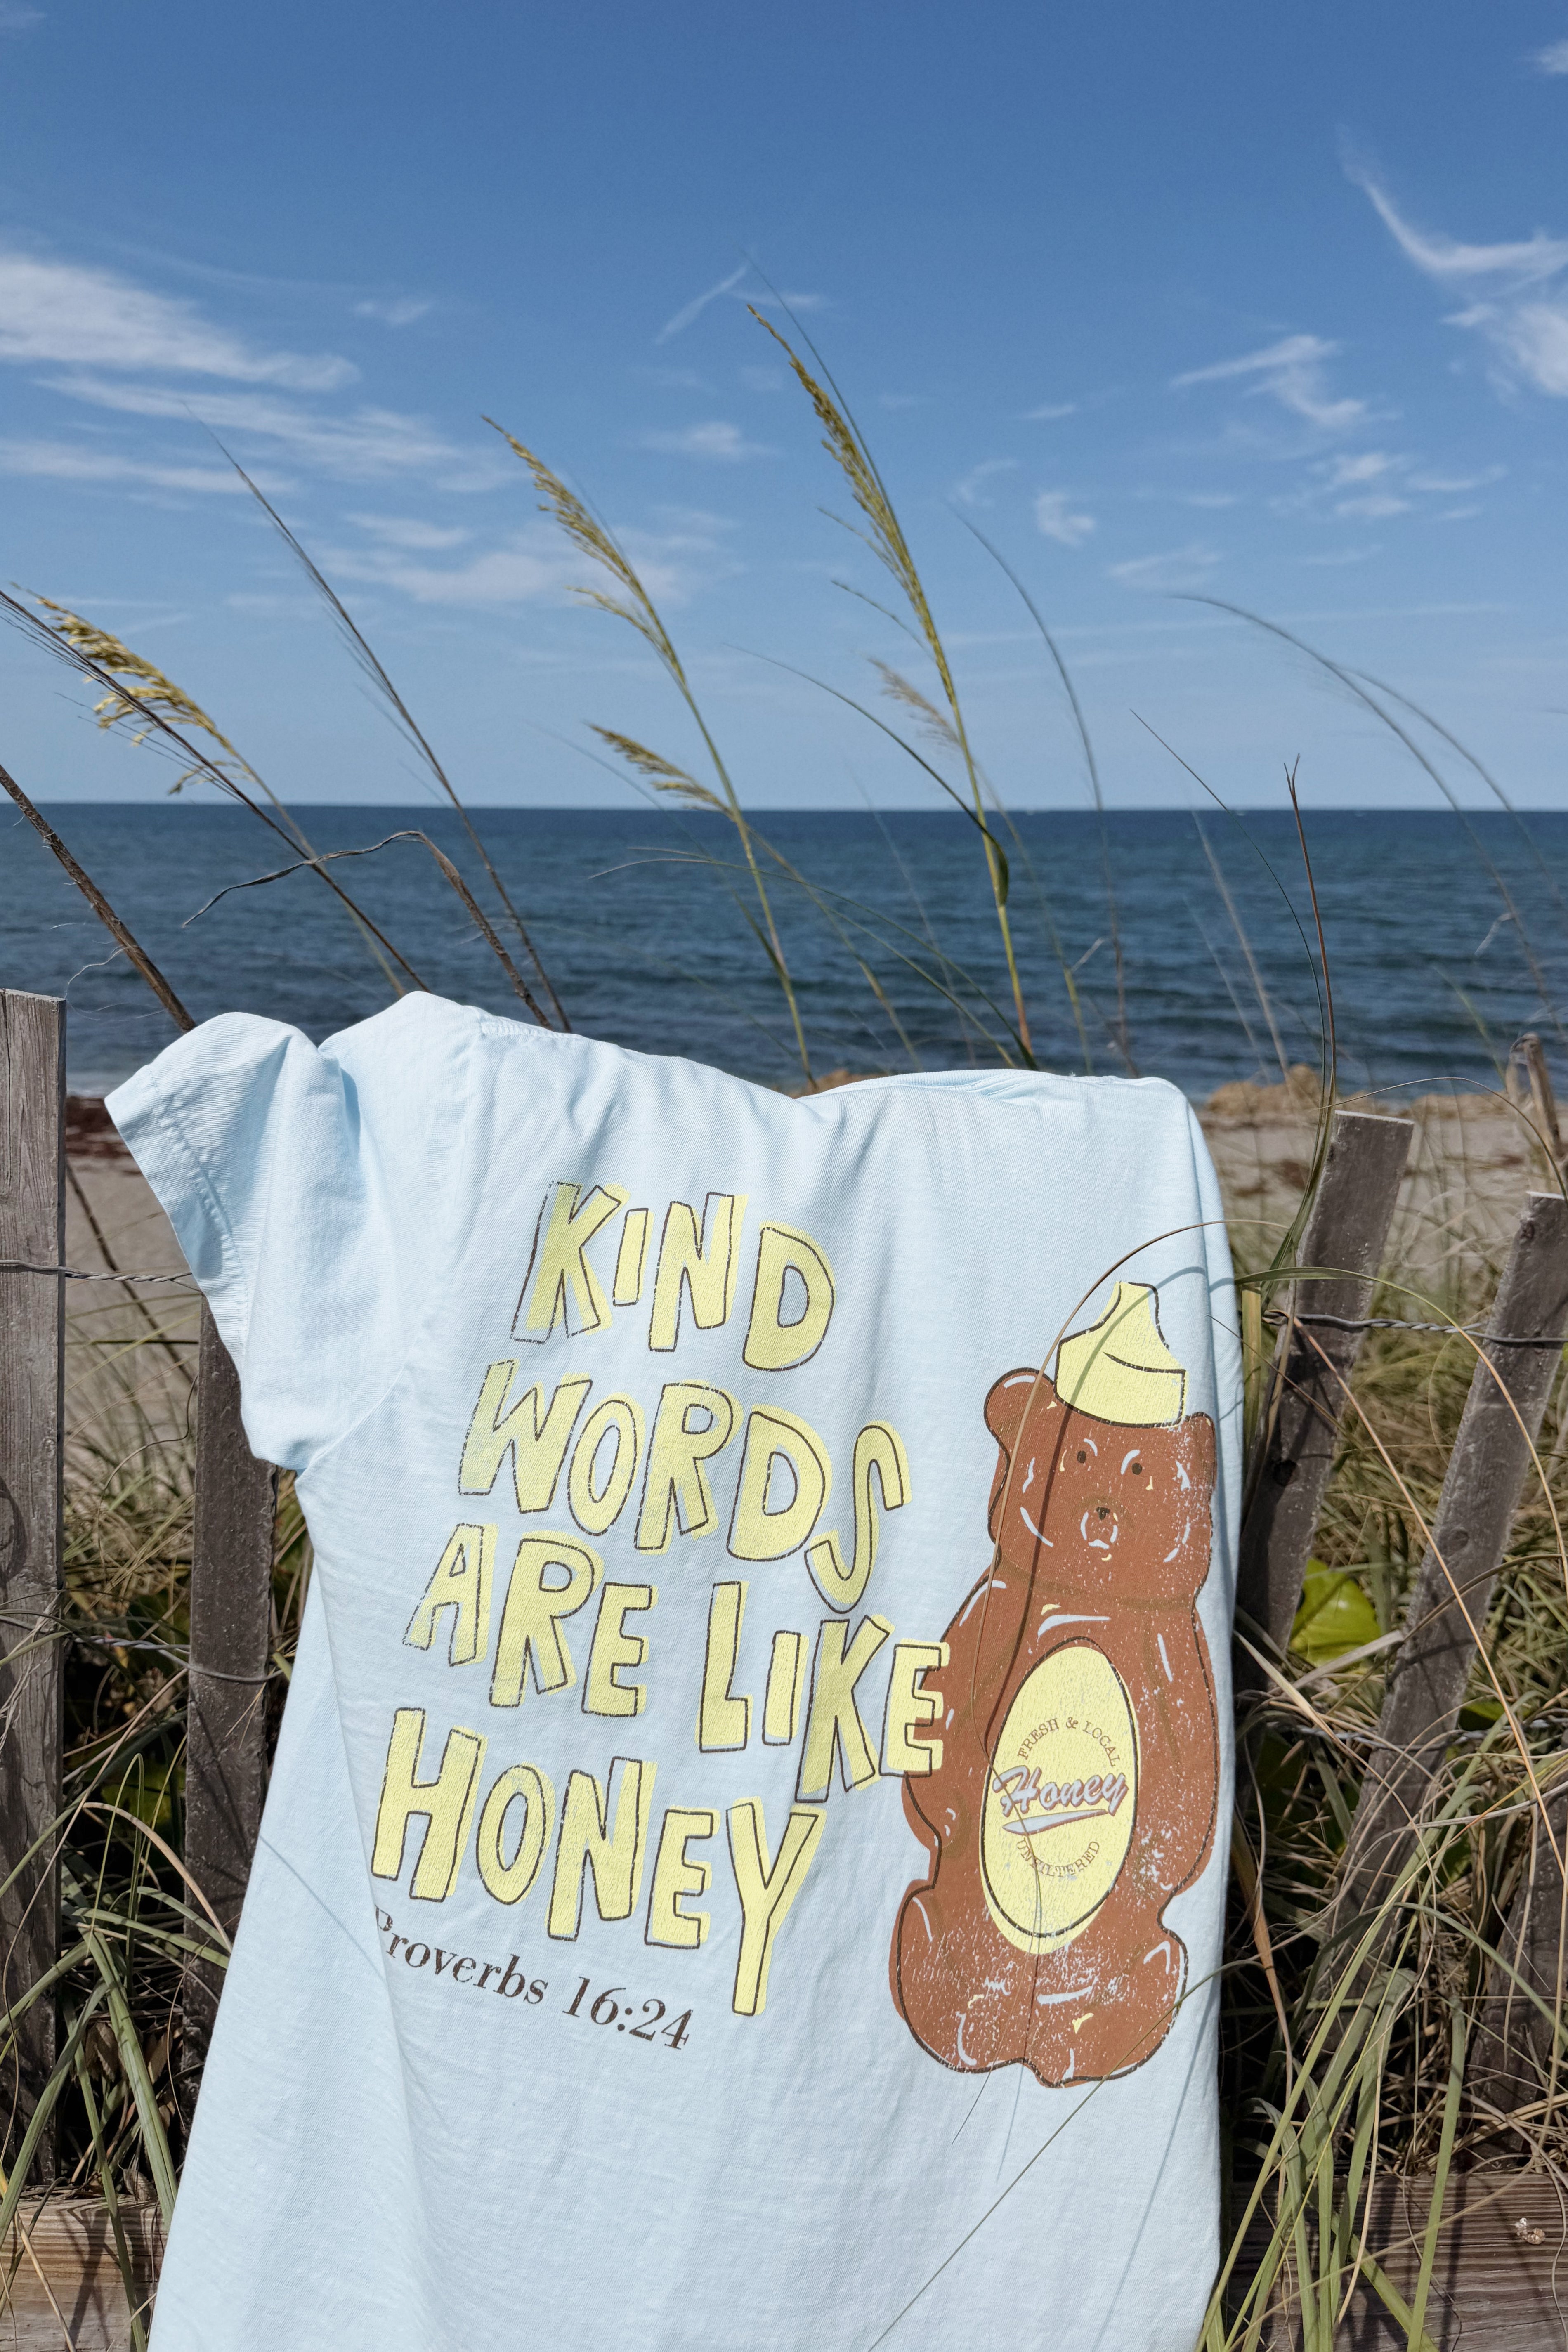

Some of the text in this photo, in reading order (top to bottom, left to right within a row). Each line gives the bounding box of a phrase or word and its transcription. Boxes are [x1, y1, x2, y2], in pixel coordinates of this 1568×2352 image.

[512, 1181, 836, 1372] KIND
[457, 1359, 910, 1614] WORDS
[402, 1523, 950, 1803] ARE LIKE
[1018, 1717, 1121, 1766] FRESH & LOCAL
[371, 1707, 826, 2017] HONEY
[992, 1765, 1129, 1816] Honey
[562, 1976, 694, 2050] 16:24
